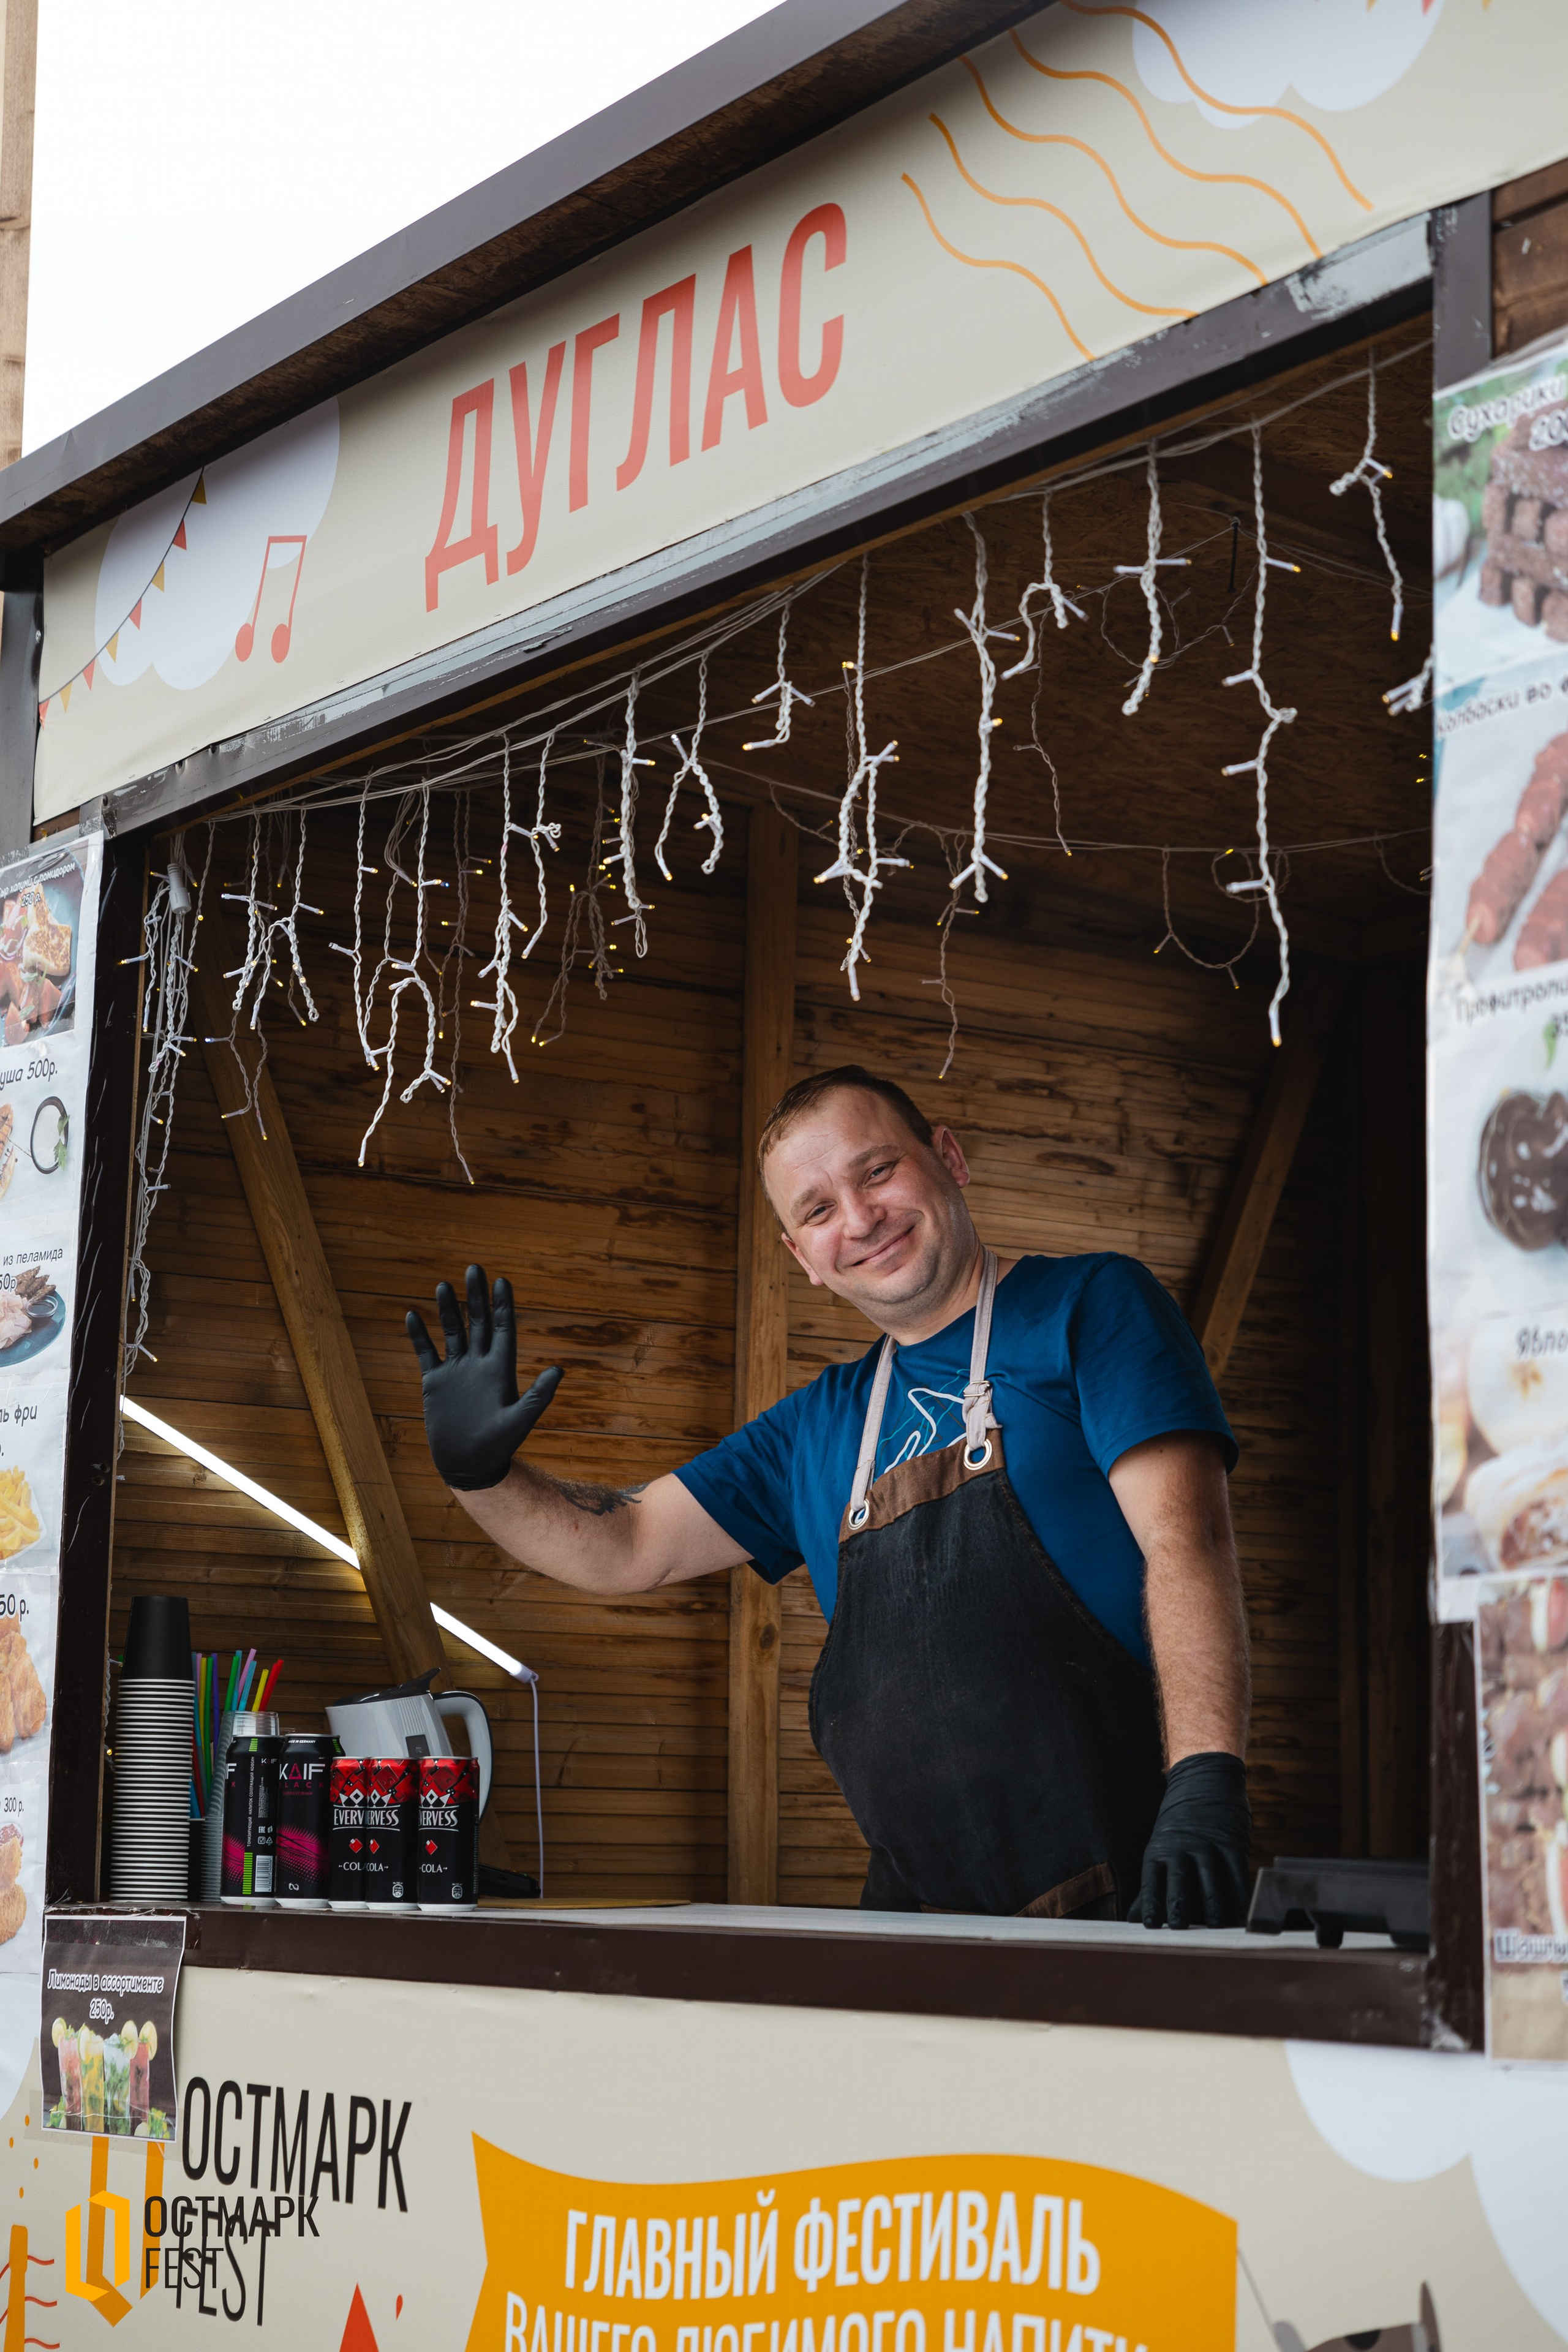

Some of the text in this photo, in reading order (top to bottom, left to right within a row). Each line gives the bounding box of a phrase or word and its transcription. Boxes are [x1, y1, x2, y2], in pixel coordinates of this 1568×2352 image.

[425, 203, 847, 613] ДУГЛАС
[1531, 407, 1568, 450] 20
[21, 892, 34, 907] 250
[27, 1058, 58, 1082] 500р.
[3, 1248, 63, 1266] из пеламида
[14, 1404, 37, 1427] фри
[279, 1763, 325, 1780] KAIF
[4, 1797, 17, 1812] 300
[418, 1809, 458, 1827] VERVESS
[421, 1864, 443, 1873] COLA
[48, 1969, 164, 1997] Лимонады в ассортименте
[90, 1999, 115, 2024] 250р.
[184, 2076, 412, 2213] ОСТМАРК
[565, 2188, 1101, 2300] ГЛАВНЫЙ ФЕСТИВАЛЬ
[176, 2206, 276, 2327] FEST
